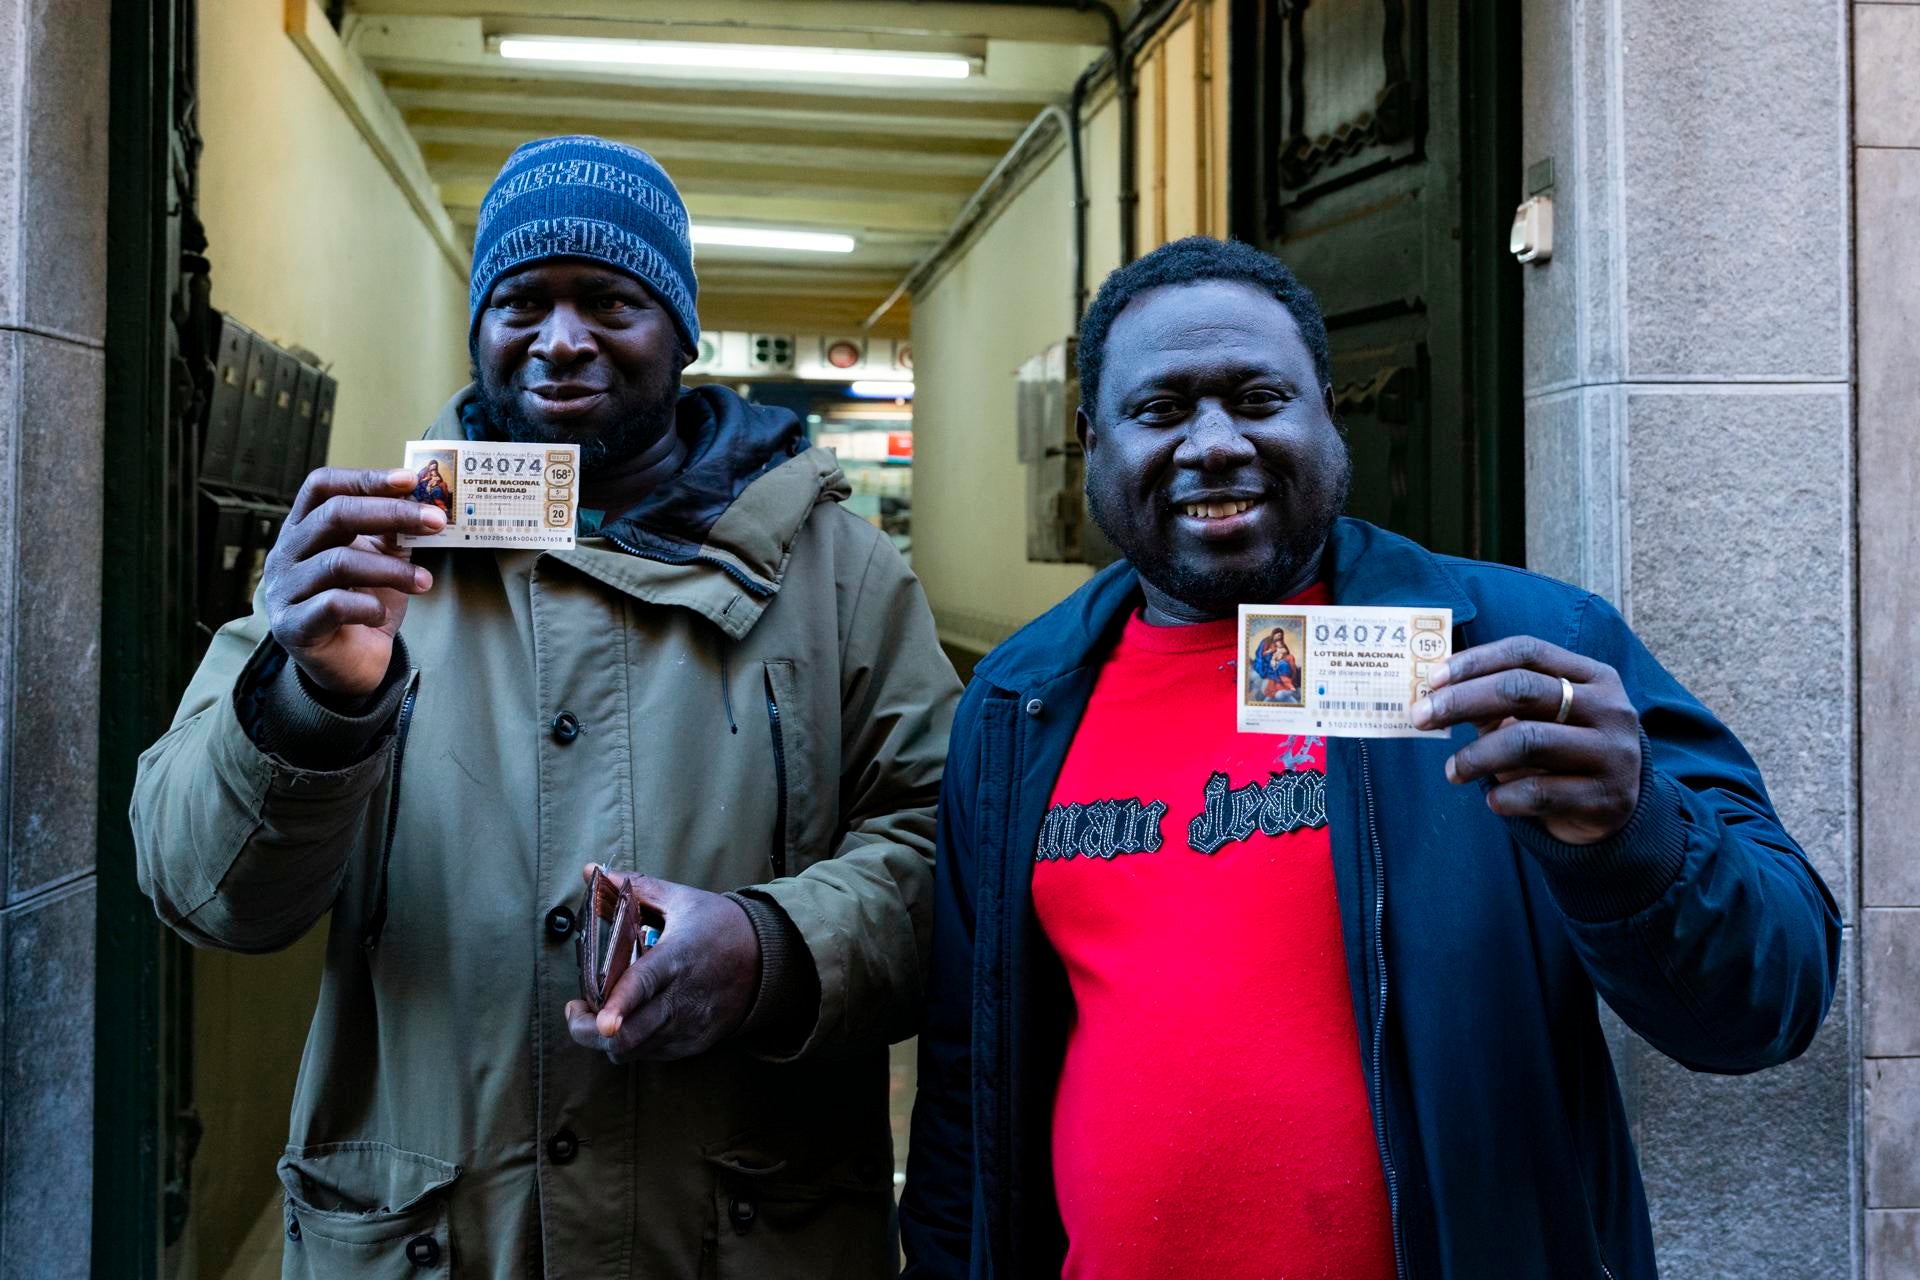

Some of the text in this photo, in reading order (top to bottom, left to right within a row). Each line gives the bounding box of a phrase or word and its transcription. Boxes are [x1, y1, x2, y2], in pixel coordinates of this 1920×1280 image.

[464, 457, 542, 473] 04074
[463, 478, 498, 486] LOTERÍA
[552, 510, 565, 519] 20
[1315, 624, 1407, 643] 04074
[1313, 649, 1406, 660] LOTERÍA NACIONAL
[1345, 661, 1389, 669] NAVIDAD
